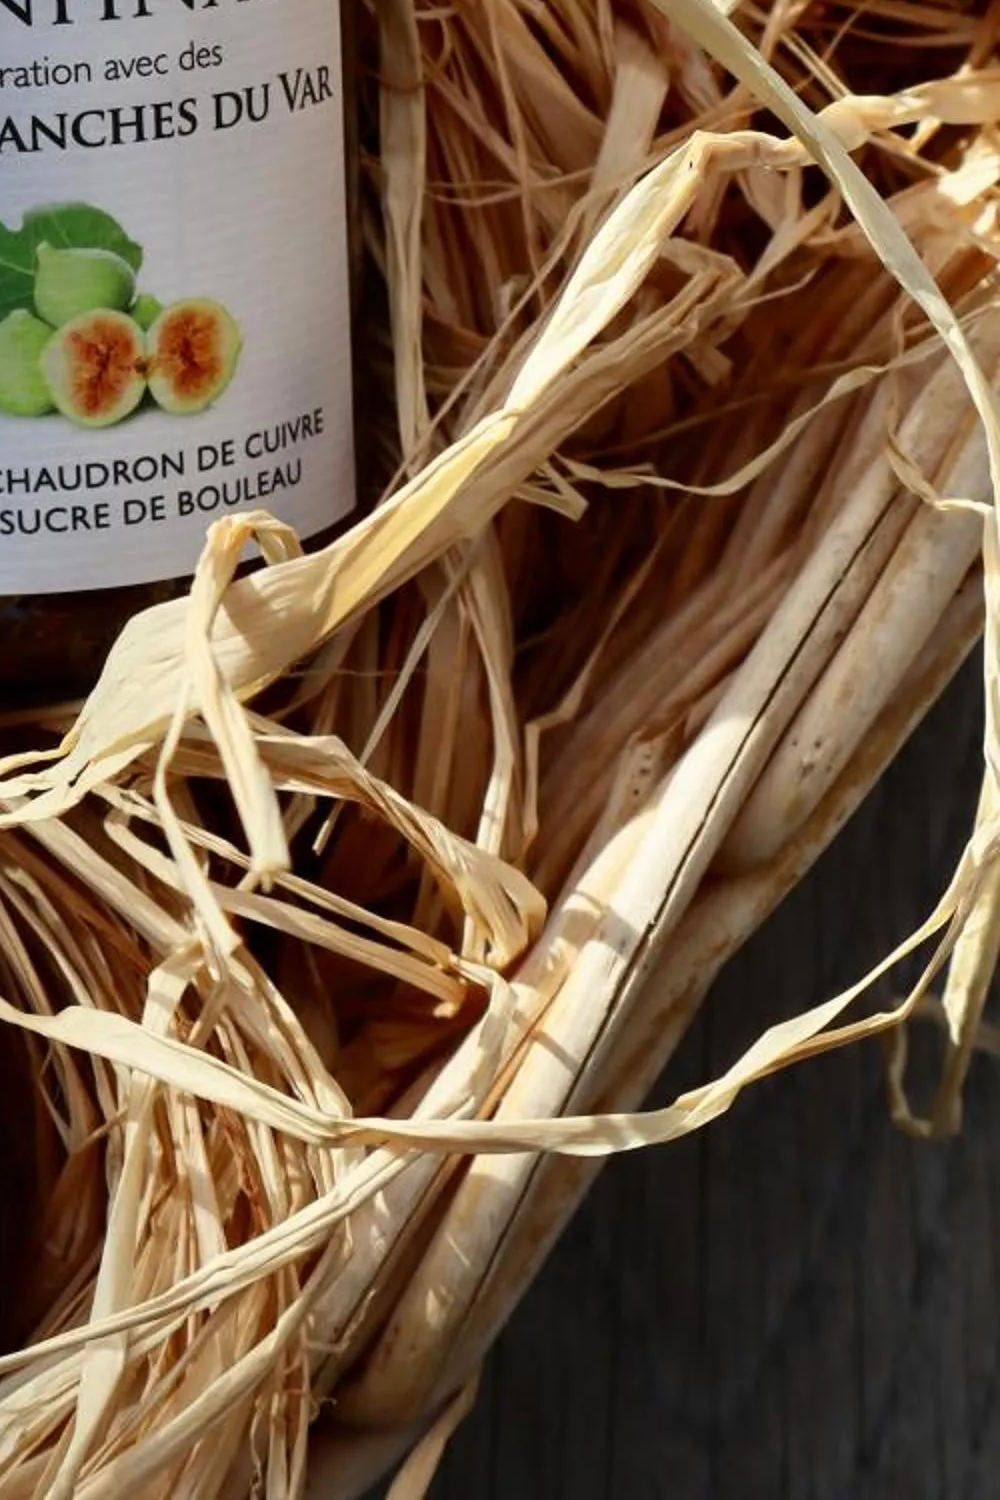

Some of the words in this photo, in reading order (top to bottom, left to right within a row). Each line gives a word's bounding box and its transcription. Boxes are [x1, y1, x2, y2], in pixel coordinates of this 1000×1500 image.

[104, 54, 169, 83] avec
[178, 40, 224, 70] des
[213, 82, 271, 132] DU
[276, 64, 334, 112] VAR
[196, 439, 236, 473] DE
[244, 407, 326, 460] CUIVRE
[0, 503, 110, 536] SUCRE
[122, 495, 166, 526] DE
[176, 459, 303, 518] BOULEAU
